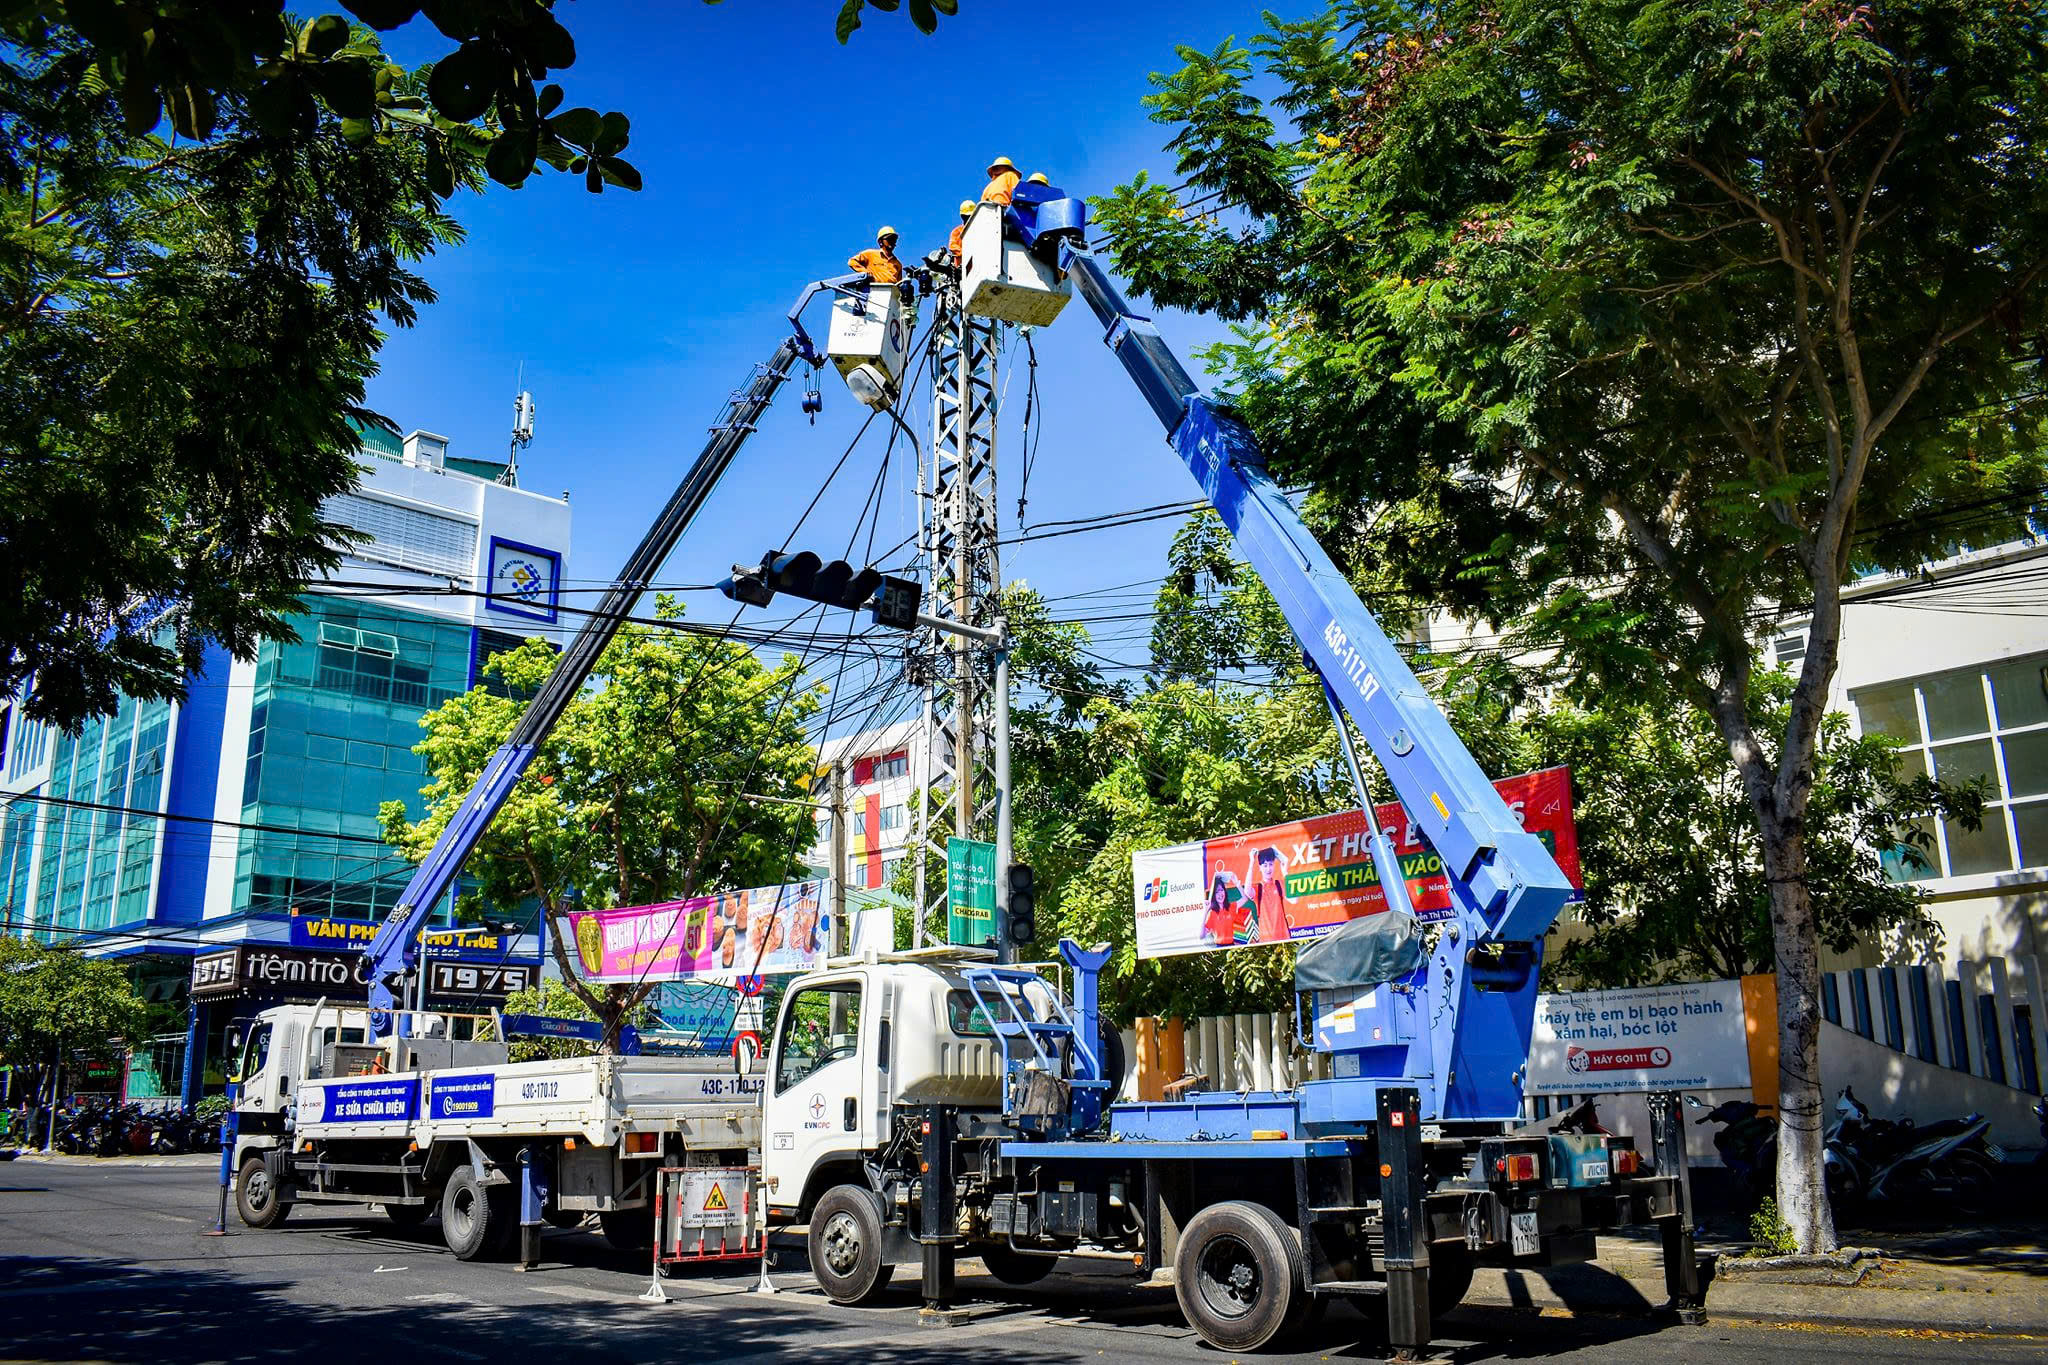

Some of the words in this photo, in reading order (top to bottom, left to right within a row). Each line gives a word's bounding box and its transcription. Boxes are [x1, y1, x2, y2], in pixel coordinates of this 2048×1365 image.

[1324, 618, 1380, 702] 43C-117.97
[1290, 833, 1336, 867] XÉT
[1287, 868, 1338, 894] TUYỂN
[1342, 860, 1380, 886] THẲ
[1404, 854, 1441, 876] VÀO
[1144, 878, 1168, 903] FPT
[1170, 882, 1195, 892] Education
[1172, 906, 1184, 914] CAO
[306, 918, 346, 938] VĂN
[194, 958, 232, 984] 1975
[248, 954, 306, 984] tiệm
[438, 968, 524, 991] 1975
[1540, 1010, 1570, 1026] thấy
[1576, 1008, 1596, 1022] trẻ
[1601, 1010, 1624, 1020] em
[1628, 1006, 1644, 1020] bị
[1648, 1004, 1678, 1020] bạo
[1683, 1000, 1723, 1015] hành
[1555, 1026, 1586, 1040] xâm
[1589, 1024, 1617, 1040] hại,
[1622, 1022, 1651, 1036] bóc
[1656, 1020, 1678, 1036] lột
[1616, 1055, 1633, 1064] GỌI
[1636, 1054, 1648, 1062] 111
[522, 1082, 558, 1098] 43C-170.12
[335, 1104, 344, 1116] XE
[386, 1098, 405, 1116] ĐIỆN
[1518, 1215, 1534, 1232] 43C
